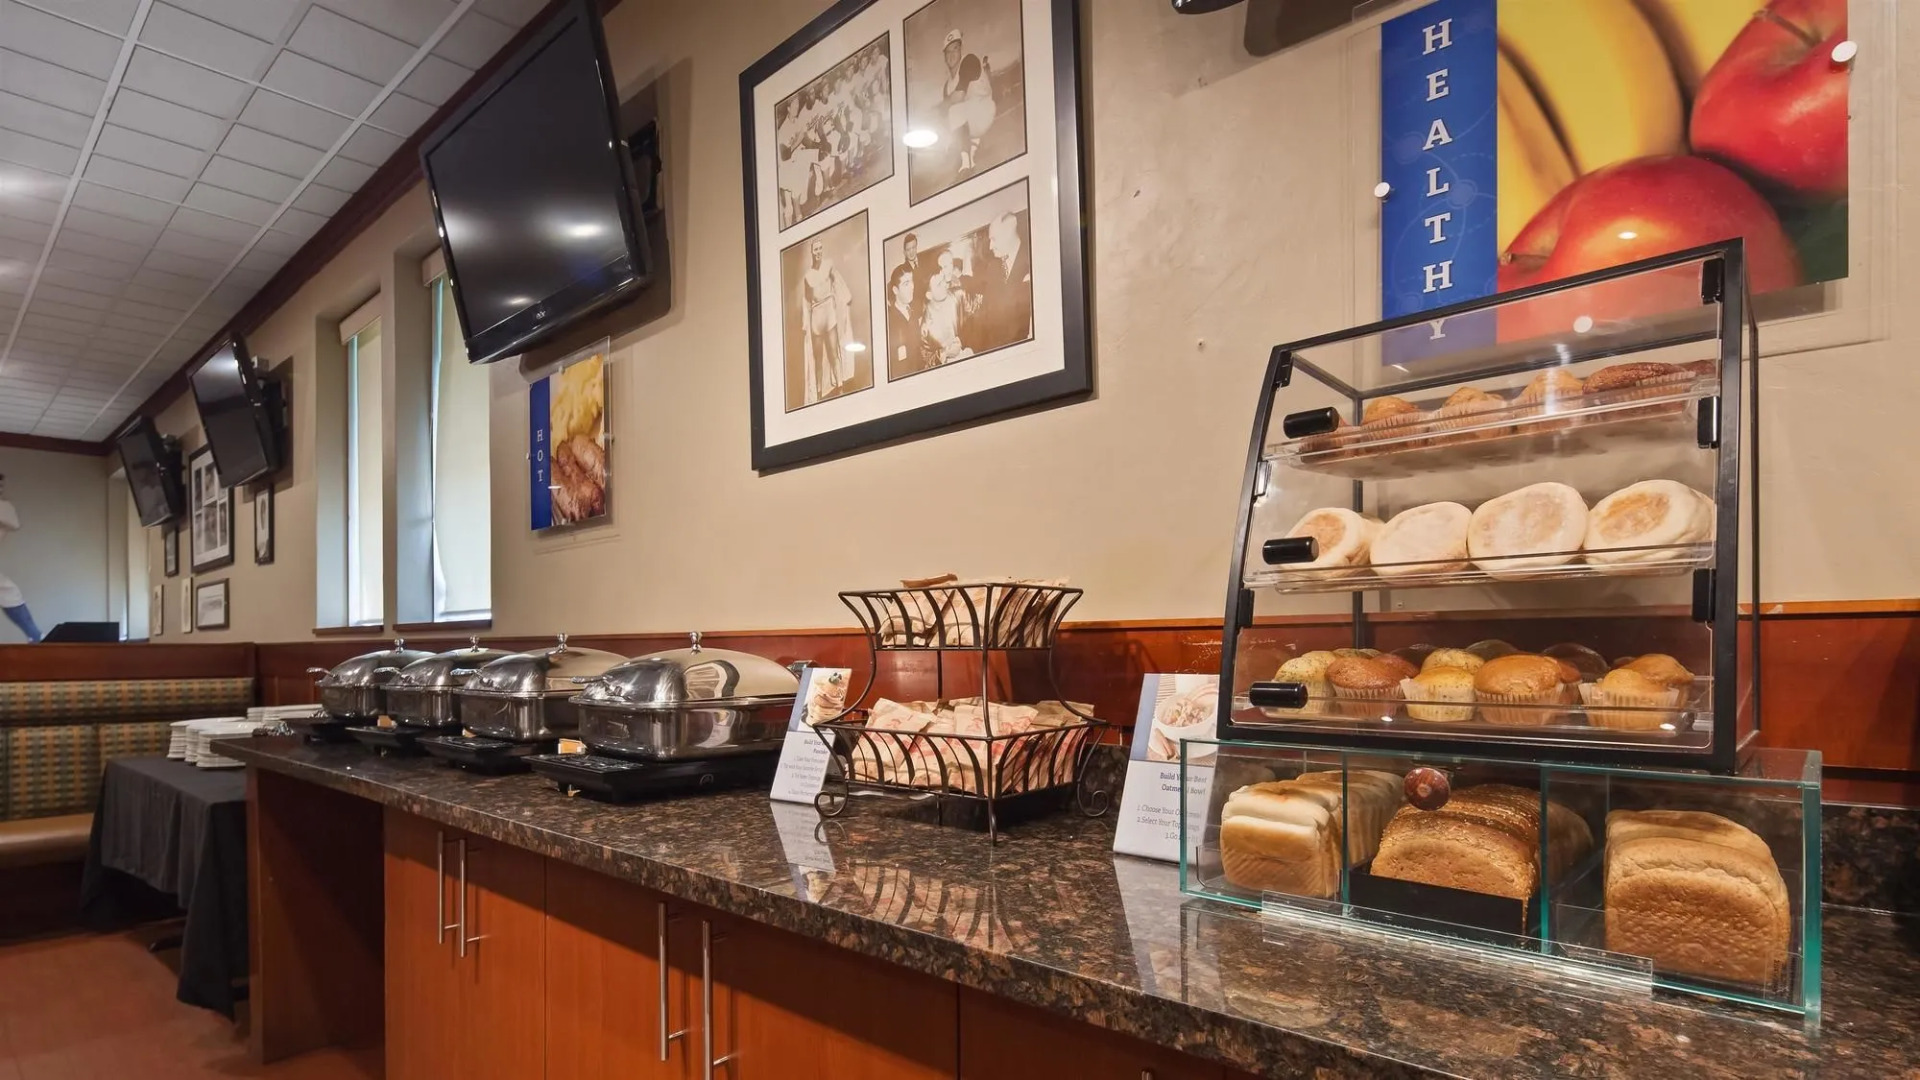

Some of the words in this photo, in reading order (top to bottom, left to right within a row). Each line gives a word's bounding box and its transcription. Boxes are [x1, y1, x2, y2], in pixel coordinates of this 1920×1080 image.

[1422, 18, 1453, 340] HEALTHY
[536, 429, 545, 482] HOT
[1160, 772, 1175, 780] Build
[1194, 775, 1207, 783] Best
[1161, 784, 1189, 793] Oatmel
[1162, 807, 1174, 815] Your
[1158, 818, 1171, 827] Your
